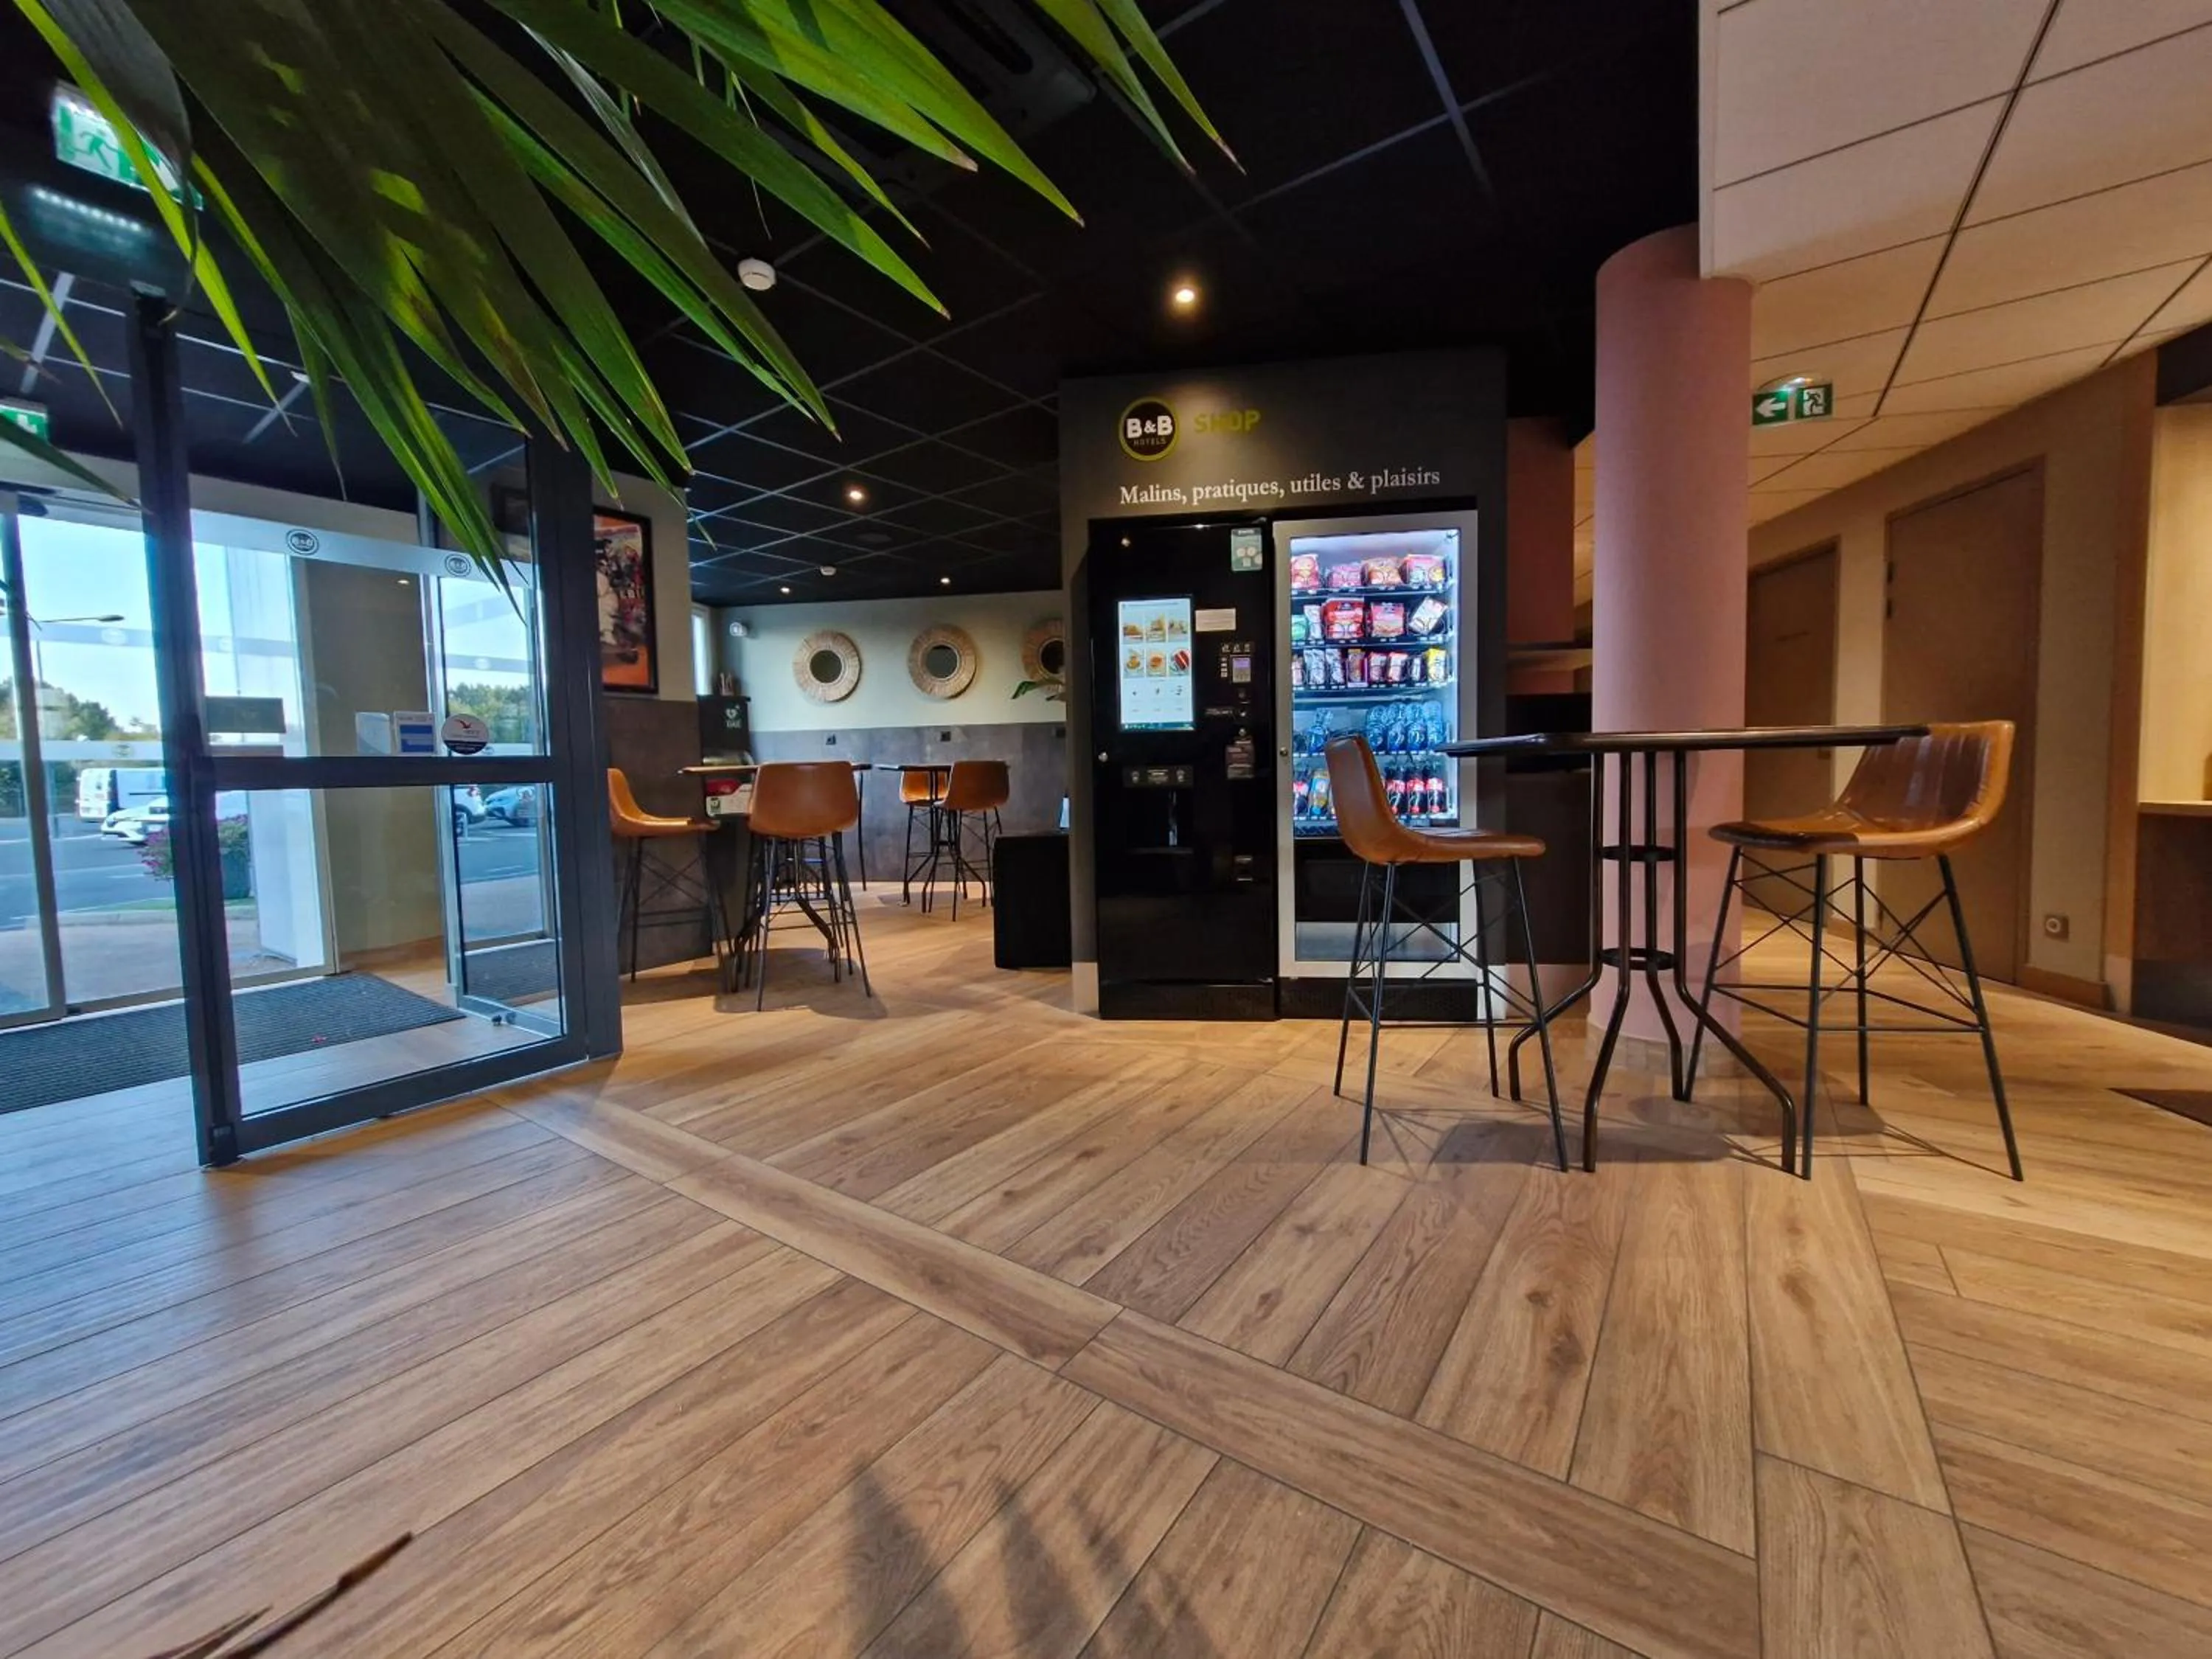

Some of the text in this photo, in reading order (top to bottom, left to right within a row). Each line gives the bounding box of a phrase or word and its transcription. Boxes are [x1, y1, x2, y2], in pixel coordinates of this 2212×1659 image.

[1126, 415, 1173, 439] B&B
[1194, 409, 1262, 434] SHOP
[1133, 438, 1166, 446] HOTELS
[1119, 466, 1441, 505] Malins, pratiques, utiles & plaisirs
